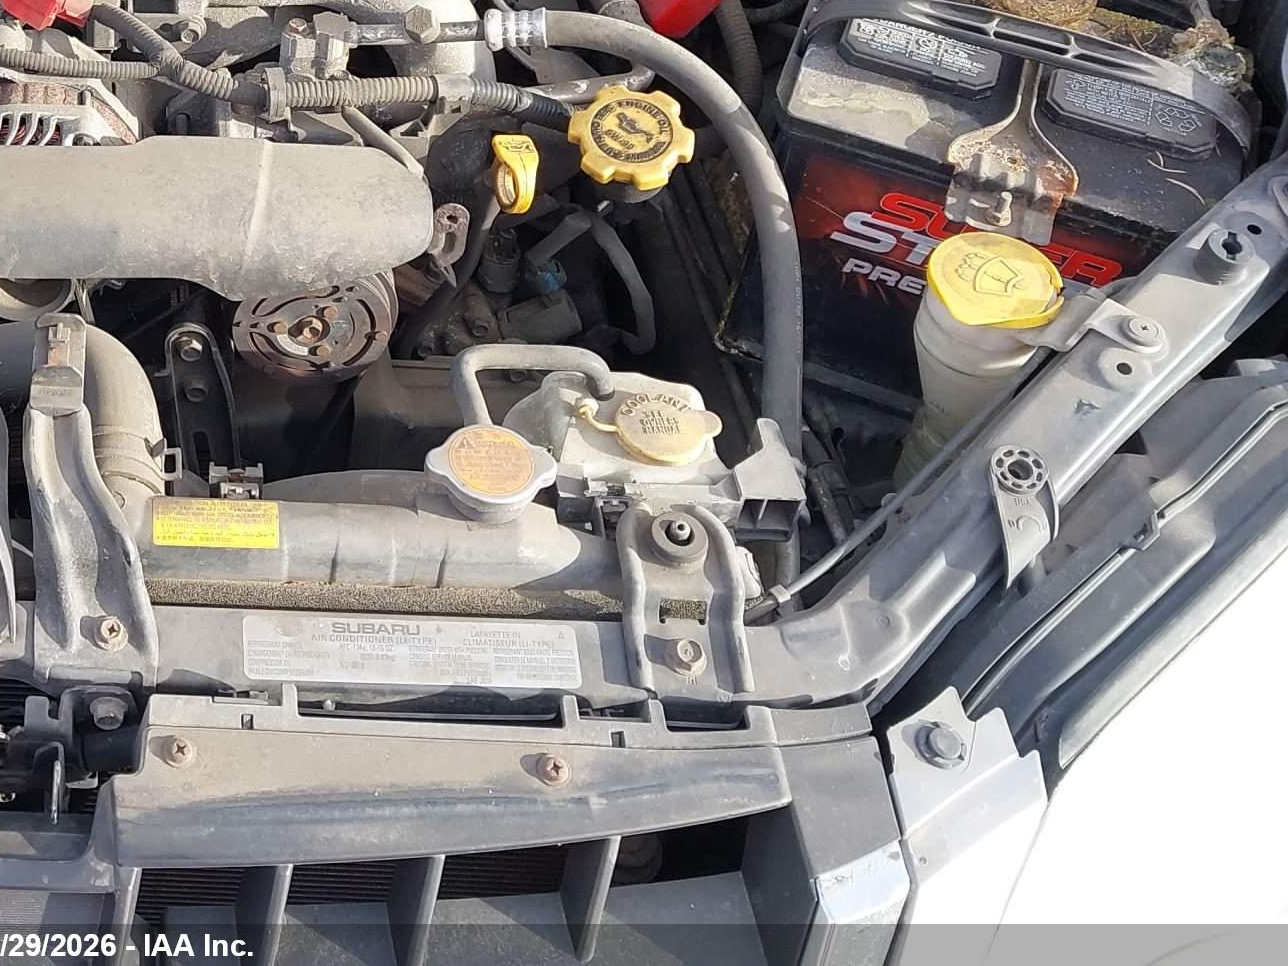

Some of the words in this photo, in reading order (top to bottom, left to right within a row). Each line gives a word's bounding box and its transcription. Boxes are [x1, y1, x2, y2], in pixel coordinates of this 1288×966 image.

[621, 393, 694, 416] COOLANT
[331, 622, 421, 636] SUBARU
[311, 634, 328, 642] AIR
[329, 634, 394, 644] CONDITIONER
